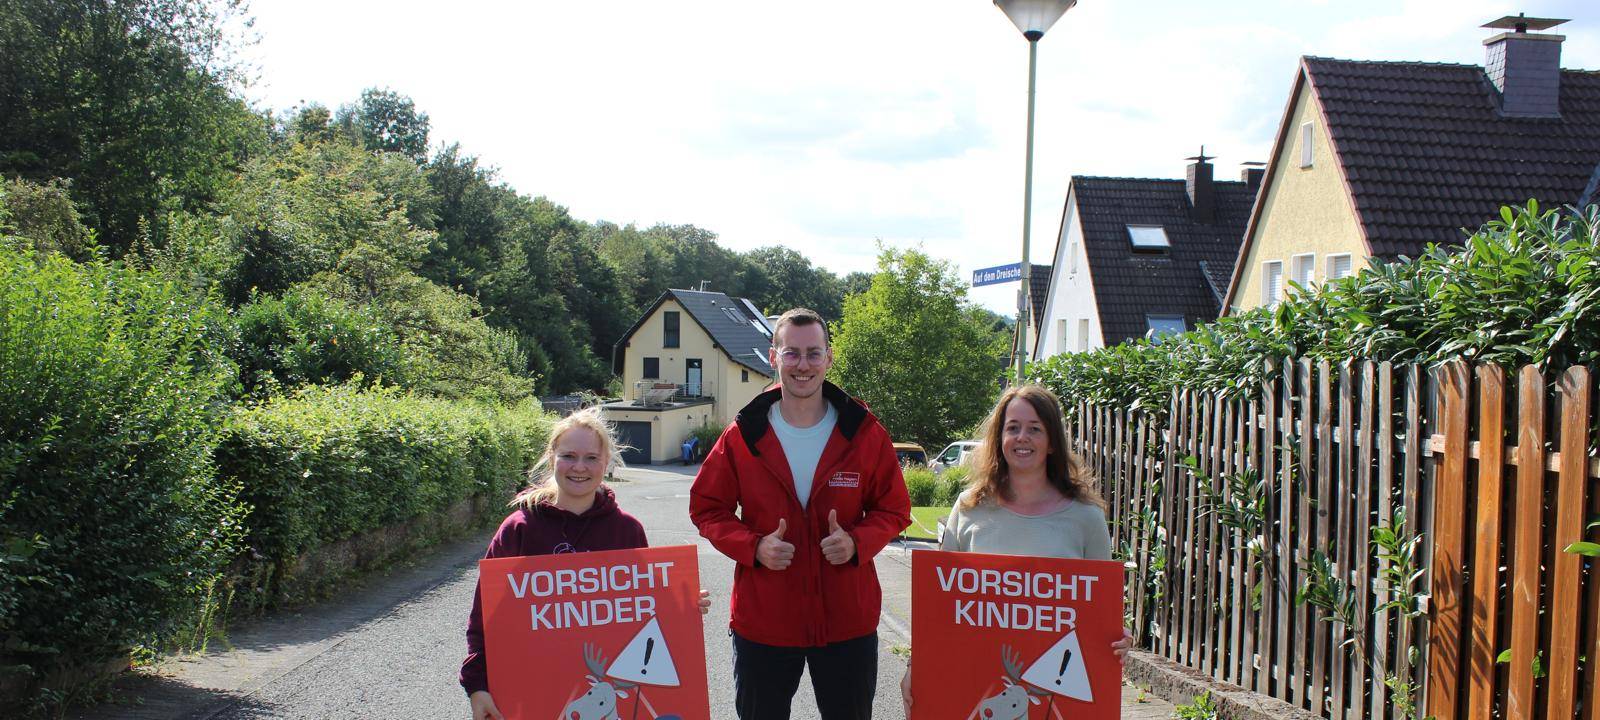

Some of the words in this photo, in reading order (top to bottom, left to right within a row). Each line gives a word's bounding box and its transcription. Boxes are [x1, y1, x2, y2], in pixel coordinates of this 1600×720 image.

[973, 272, 983, 283] Auf
[984, 271, 996, 282] dem
[507, 562, 674, 599] VORSICHT
[936, 567, 1099, 601] VORSICHT
[531, 596, 656, 630] KINDER
[955, 600, 1077, 632] KINDER
